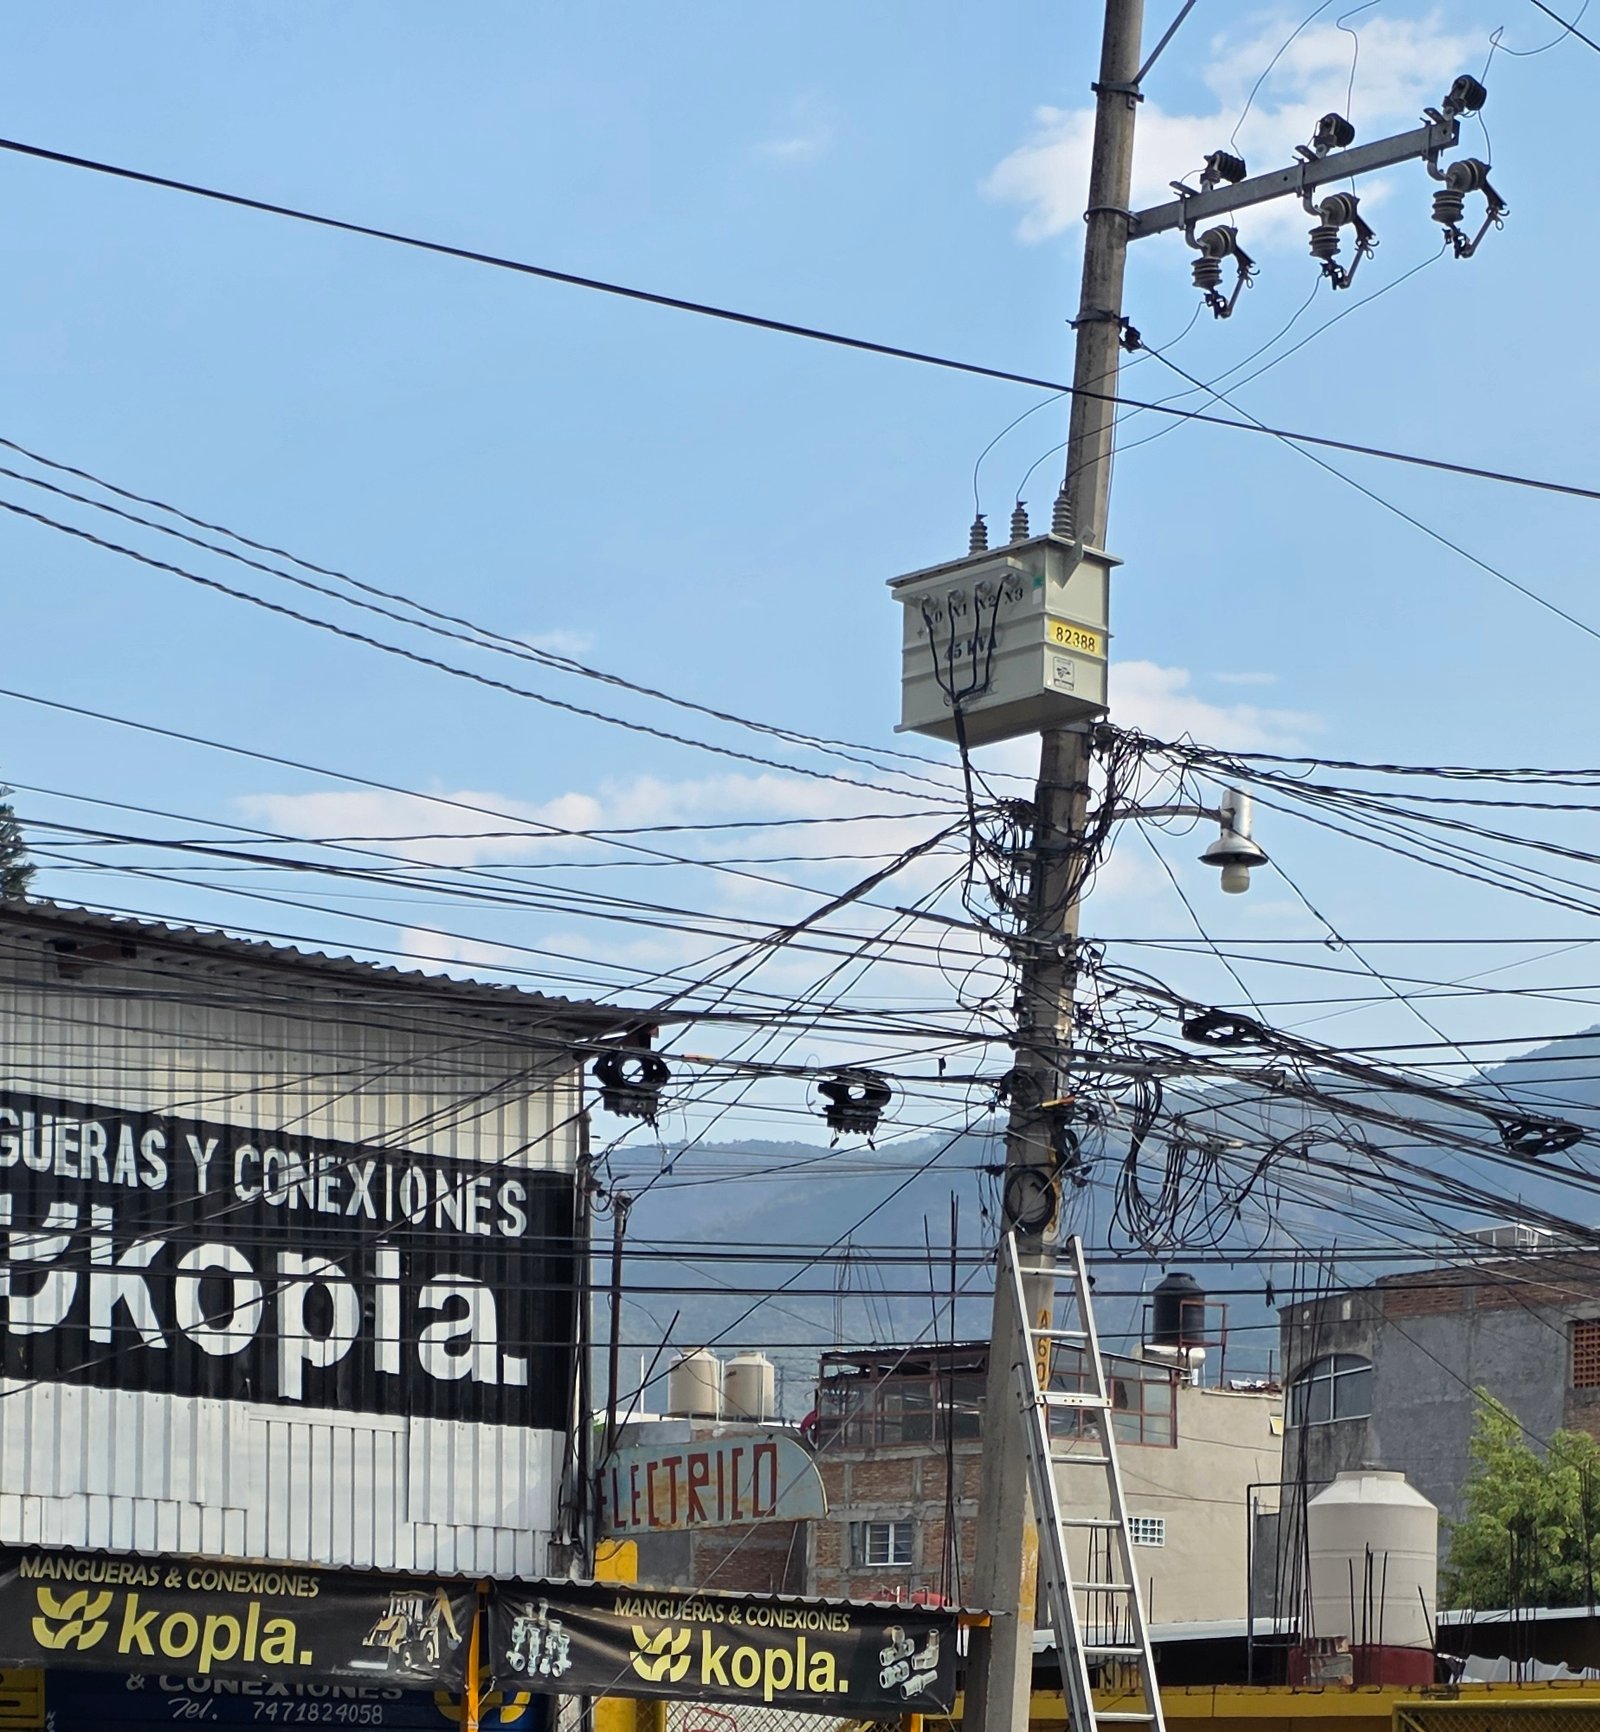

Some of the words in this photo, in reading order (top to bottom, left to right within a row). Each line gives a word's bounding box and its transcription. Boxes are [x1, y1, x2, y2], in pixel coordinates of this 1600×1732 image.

[1056, 626, 1096, 652] 82388
[186, 1134, 219, 1194] Y
[234, 1145, 528, 1238] CONEXIONES
[20, 1555, 160, 1587] MANGUERAS
[164, 1567, 182, 1589] &
[187, 1568, 320, 1598] CONEXIONES
[613, 1597, 724, 1624] MANGUERAS
[728, 1604, 741, 1625] &
[746, 1607, 850, 1633] CONEXIONES
[126, 1673, 145, 1691] &
[168, 1697, 218, 1720] Tel.
[253, 1701, 383, 1725] 7471824058
